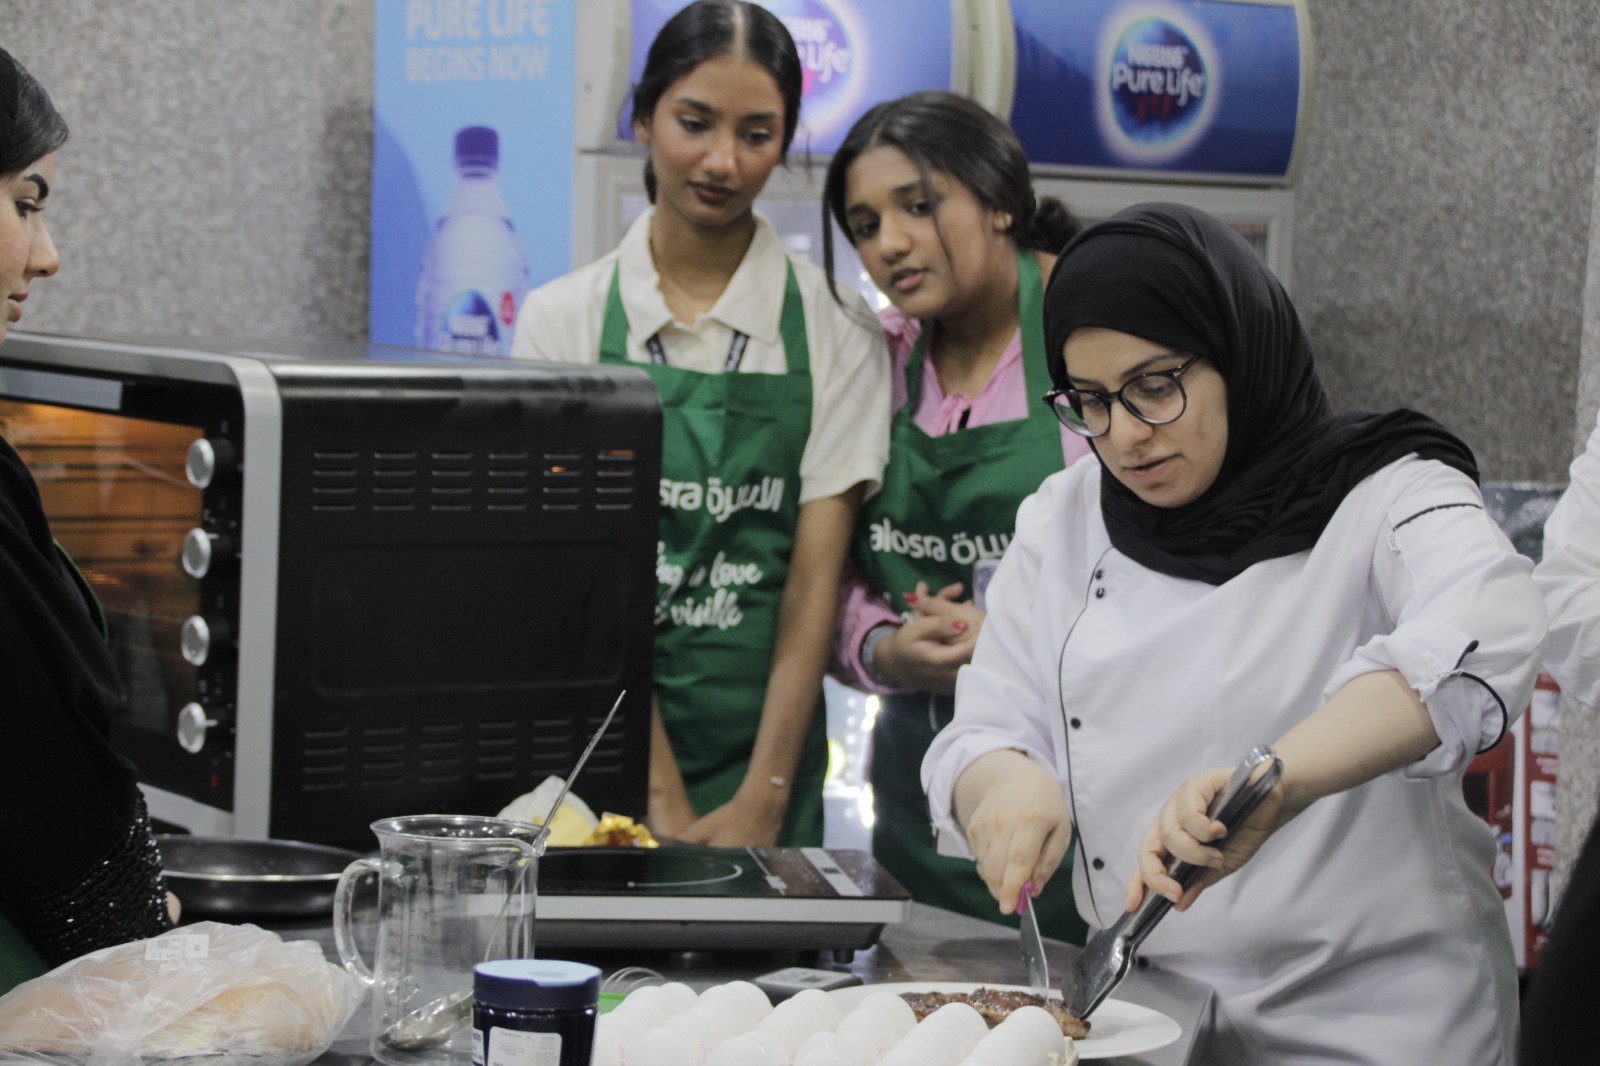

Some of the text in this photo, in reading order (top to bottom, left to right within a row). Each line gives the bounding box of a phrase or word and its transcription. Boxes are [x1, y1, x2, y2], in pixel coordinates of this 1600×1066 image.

[405, 0, 551, 39] PURE LIFE
[405, 45, 550, 83] BEGINS NOW
[1112, 61, 1205, 107] Pure Life
[869, 517, 947, 563] alosra
[709, 551, 764, 589] love
